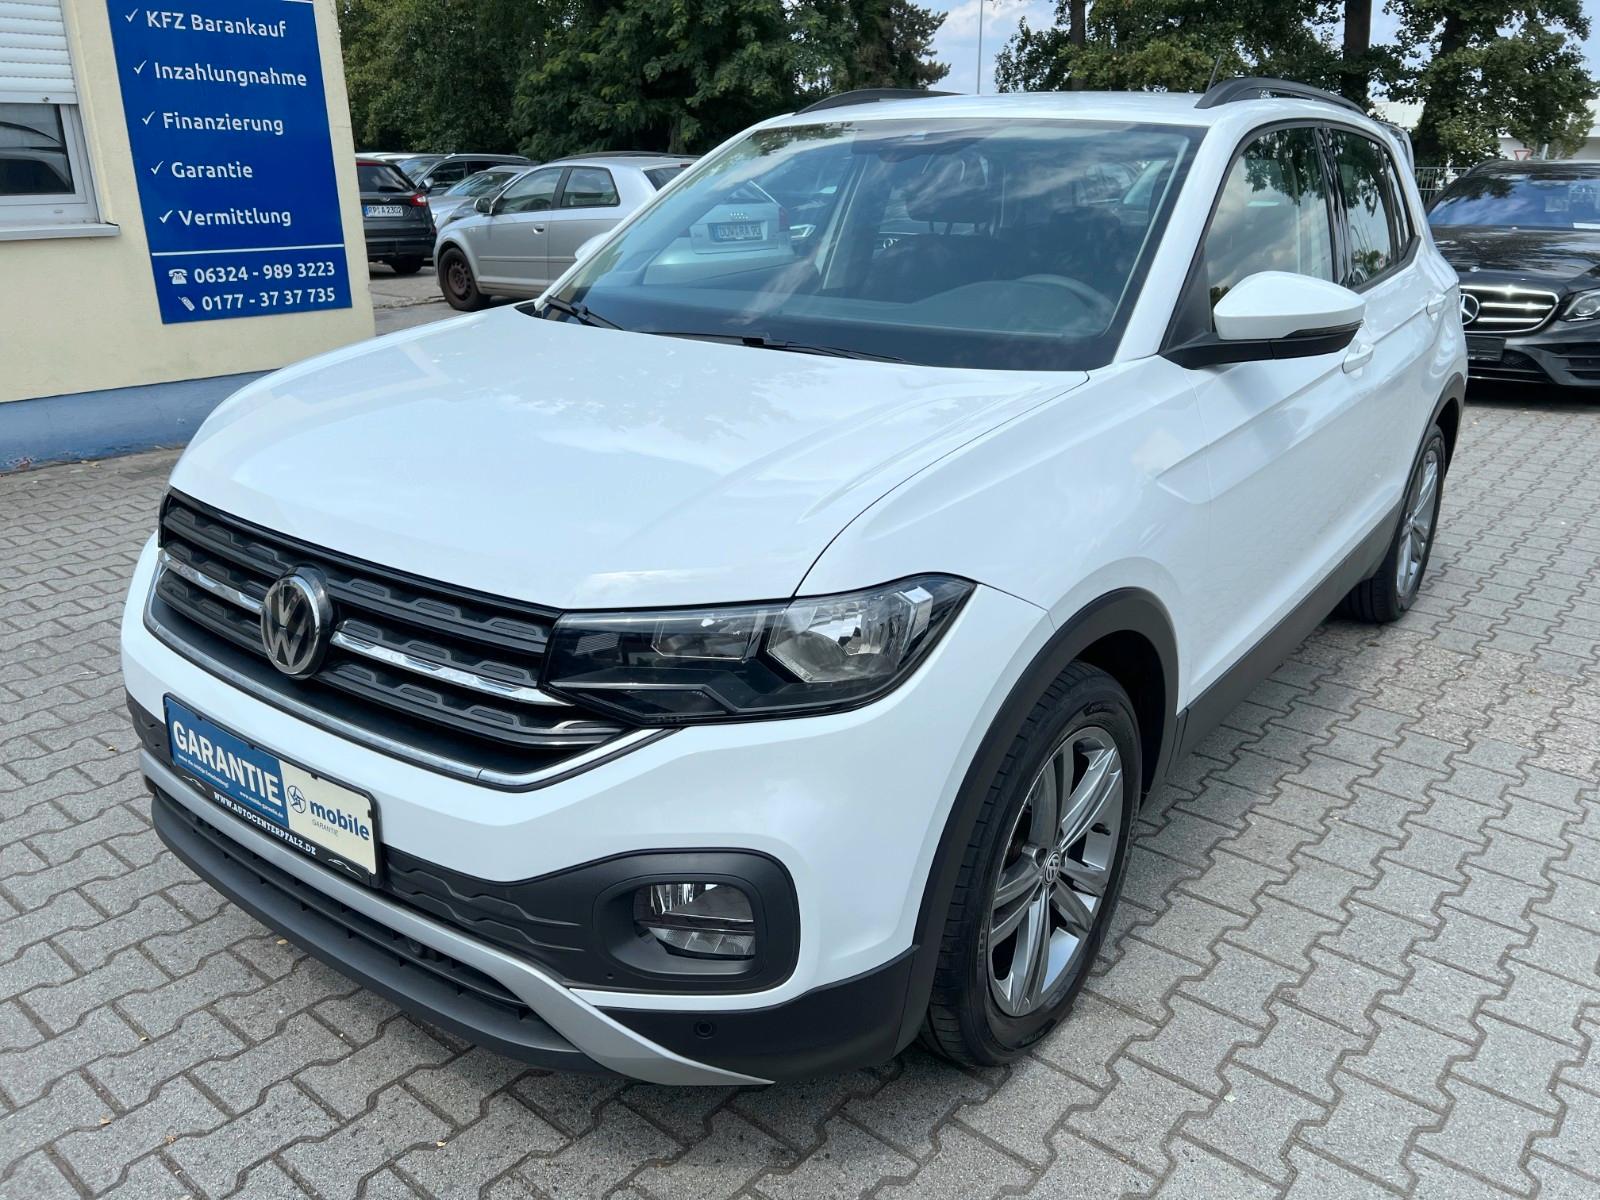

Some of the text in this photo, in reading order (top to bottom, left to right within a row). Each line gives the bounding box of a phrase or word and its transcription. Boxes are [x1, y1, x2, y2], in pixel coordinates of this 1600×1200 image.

[146, 10, 287, 38] KFZ Barankauf
[154, 62, 307, 87] Inzahlungnahme
[162, 111, 284, 136] Finanzierung
[171, 160, 253, 178] Garantie
[178, 207, 292, 227] Vermittlung
[194, 266, 249, 284] 06324
[262, 263, 293, 280] 989
[297, 261, 335, 278] 3223
[202, 293, 244, 311] 0177
[259, 291, 279, 307] 37
[283, 289, 303, 305] 37
[307, 287, 336, 303] 735
[172, 720, 282, 807] GARANTIE
[213, 791, 317, 856] WWW.AUTOCENTERPFALZ.DE
[309, 800, 370, 841] mobile
